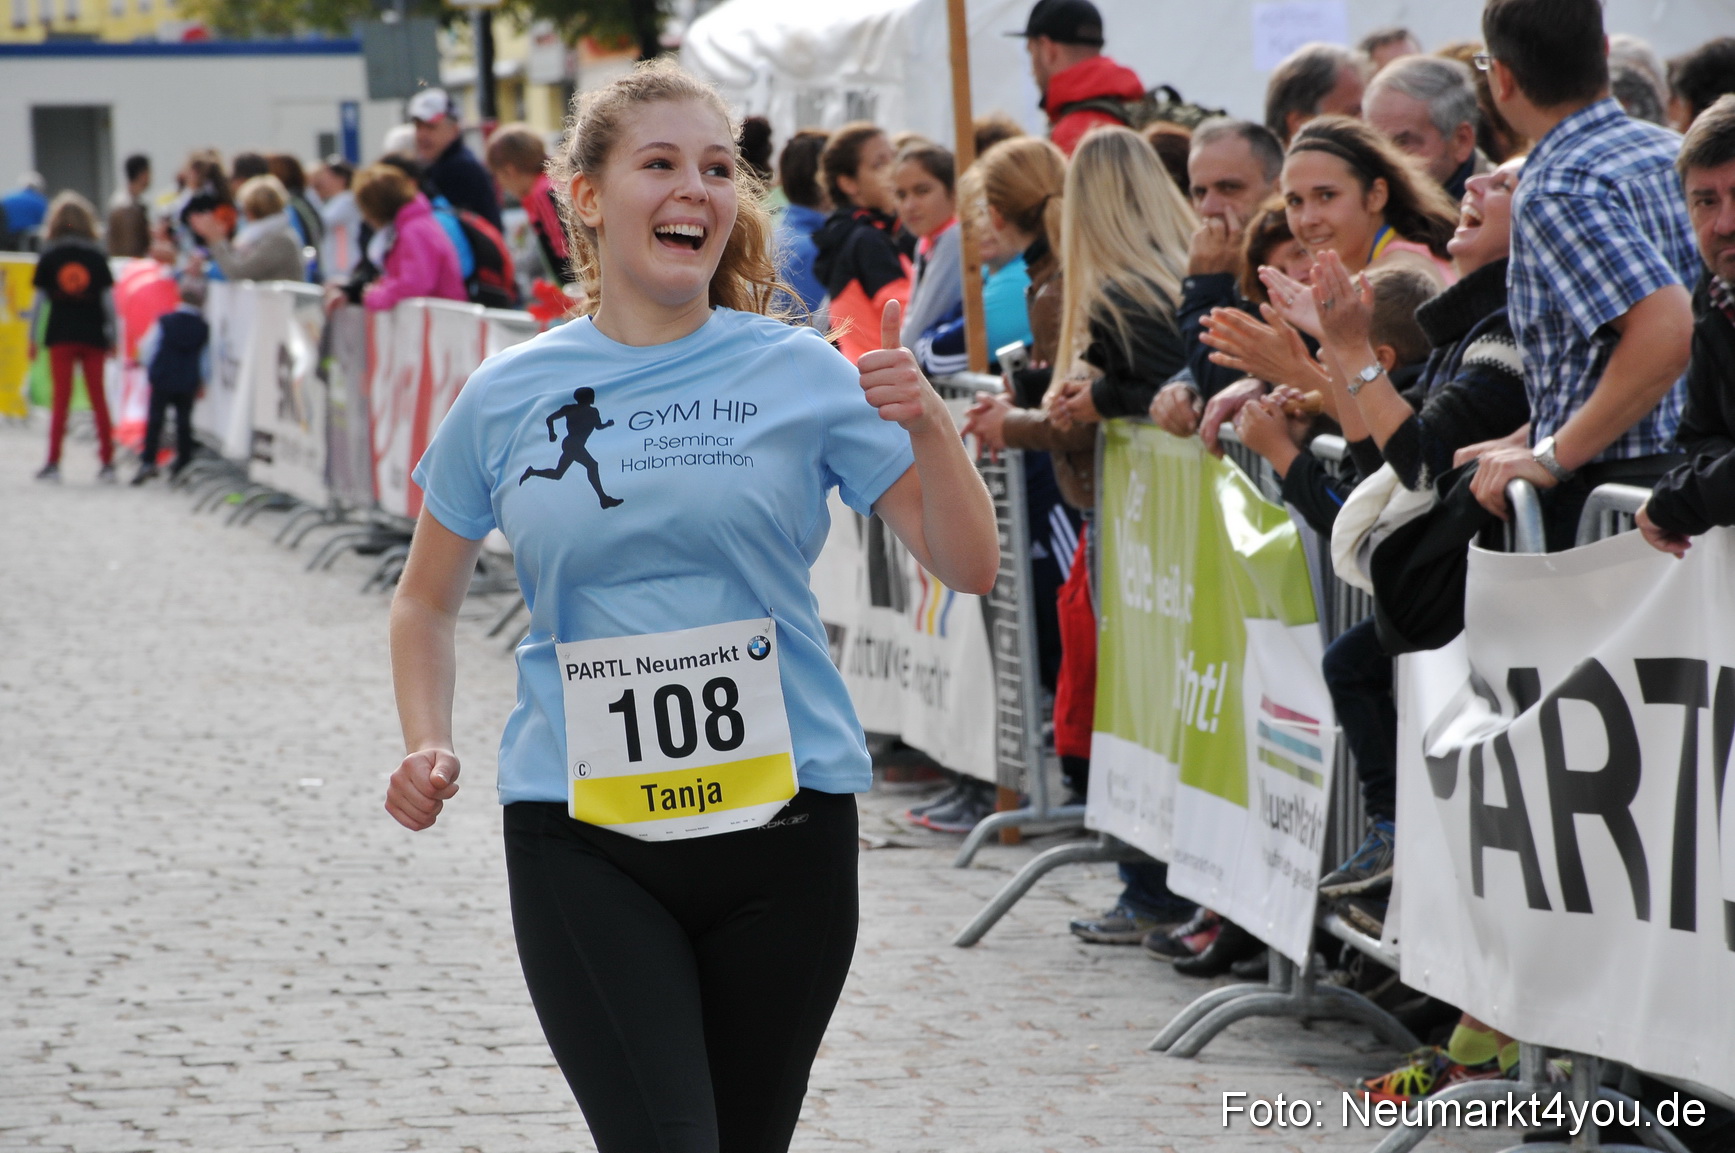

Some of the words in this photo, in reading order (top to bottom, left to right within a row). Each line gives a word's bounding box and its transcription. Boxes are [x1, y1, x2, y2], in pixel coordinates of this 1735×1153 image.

[628, 399, 700, 431] GYM
[713, 399, 758, 424] HIP
[643, 432, 734, 452] P-Seminar
[621, 451, 754, 473] Halbmarathon
[566, 658, 632, 681] PARTL
[636, 645, 740, 675] Neumarkt
[608, 676, 745, 763] 108
[577, 762, 588, 777] C
[640, 777, 723, 813] Tanja
